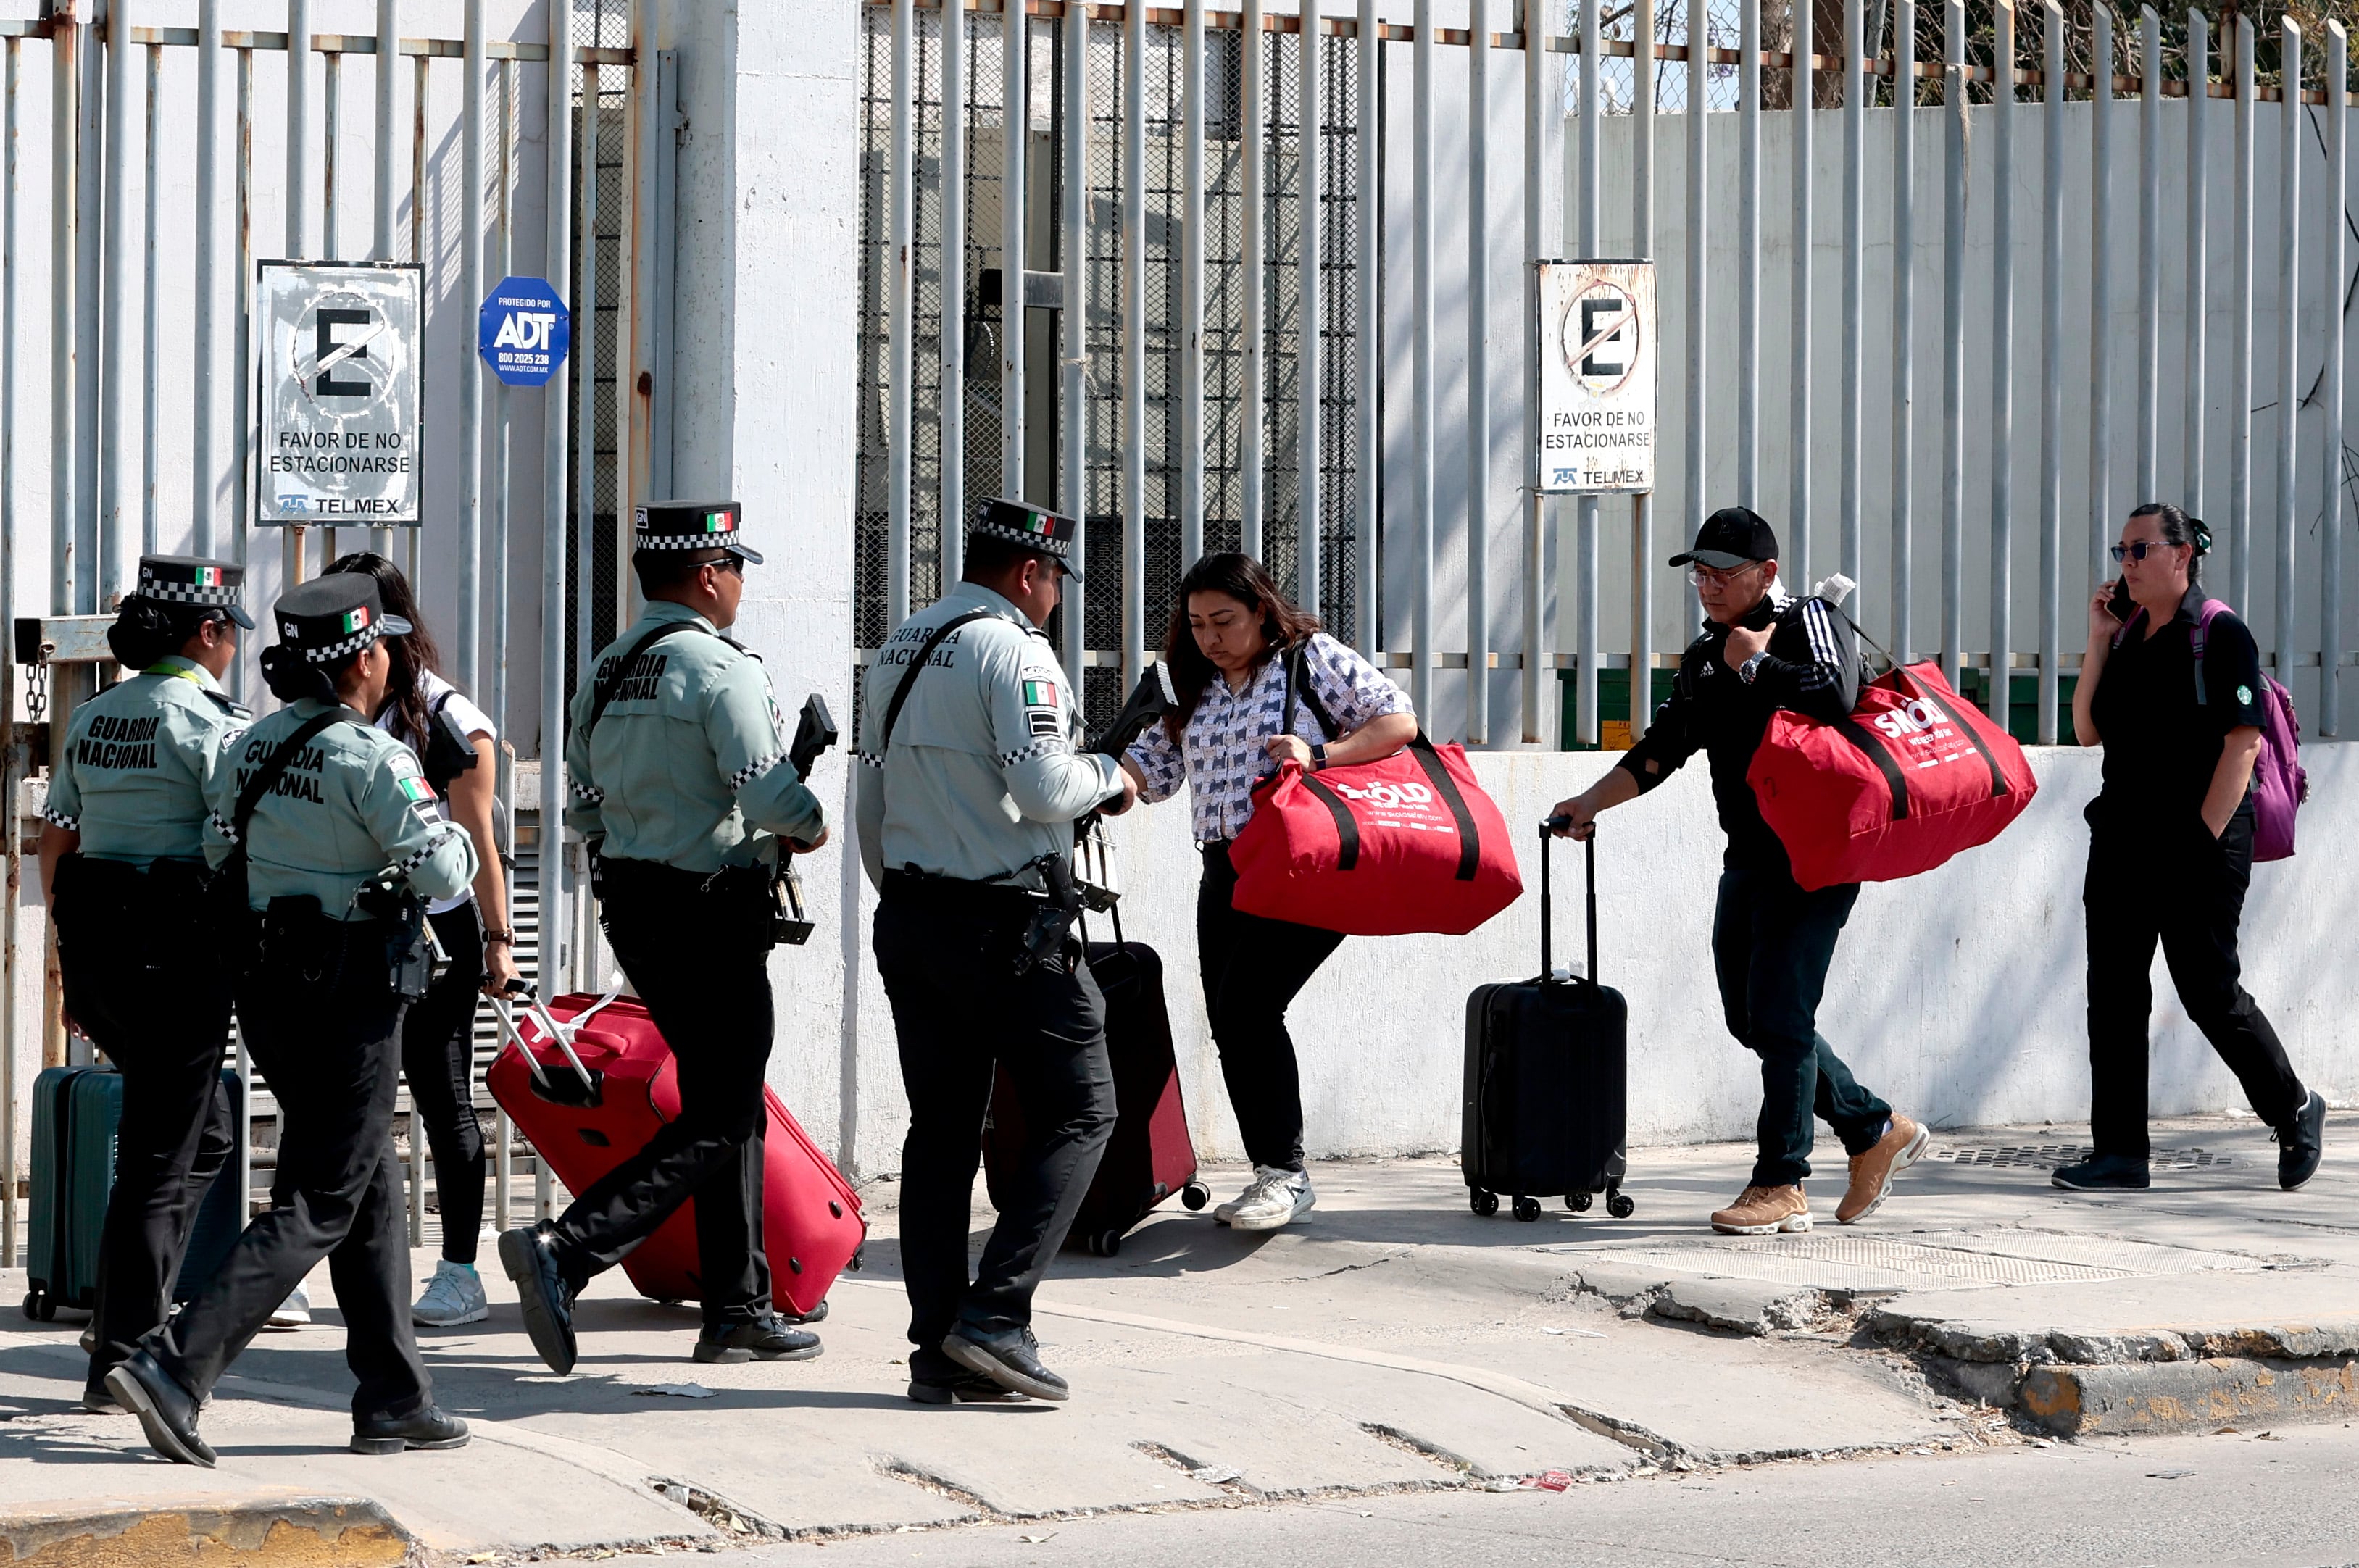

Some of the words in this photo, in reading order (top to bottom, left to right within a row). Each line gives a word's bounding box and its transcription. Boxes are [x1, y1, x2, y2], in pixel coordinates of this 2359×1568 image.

[499, 298, 536, 307] PROTEGIDO
[537, 299, 551, 308] POR
[498, 352, 513, 363] 800
[515, 353, 533, 364] 2025
[535, 354, 549, 364] 238
[499, 364, 549, 373] WWW.ADT.COM.MX
[1554, 412, 1602, 427] FAVOR
[1607, 412, 1624, 426] DE
[1628, 411, 1644, 425] NO
[280, 432, 339, 449] FAVOR
[346, 433, 370, 449] DE
[375, 433, 402, 449] NO
[1546, 433, 1649, 449] ESTACIONARSE
[270, 456, 410, 473] ESTACIONARSE
[1583, 470, 1644, 484] TELMEX
[315, 499, 399, 514] TELMEX
[637, 512, 646, 523] GN
[143, 567, 153, 579] GN
[284, 622, 299, 638] GN
[878, 649, 954, 669] NACINAL
[88, 715, 160, 743] GUARDIA
[78, 739, 157, 770] NACIONAL
[244, 740, 325, 773] GUDIA
